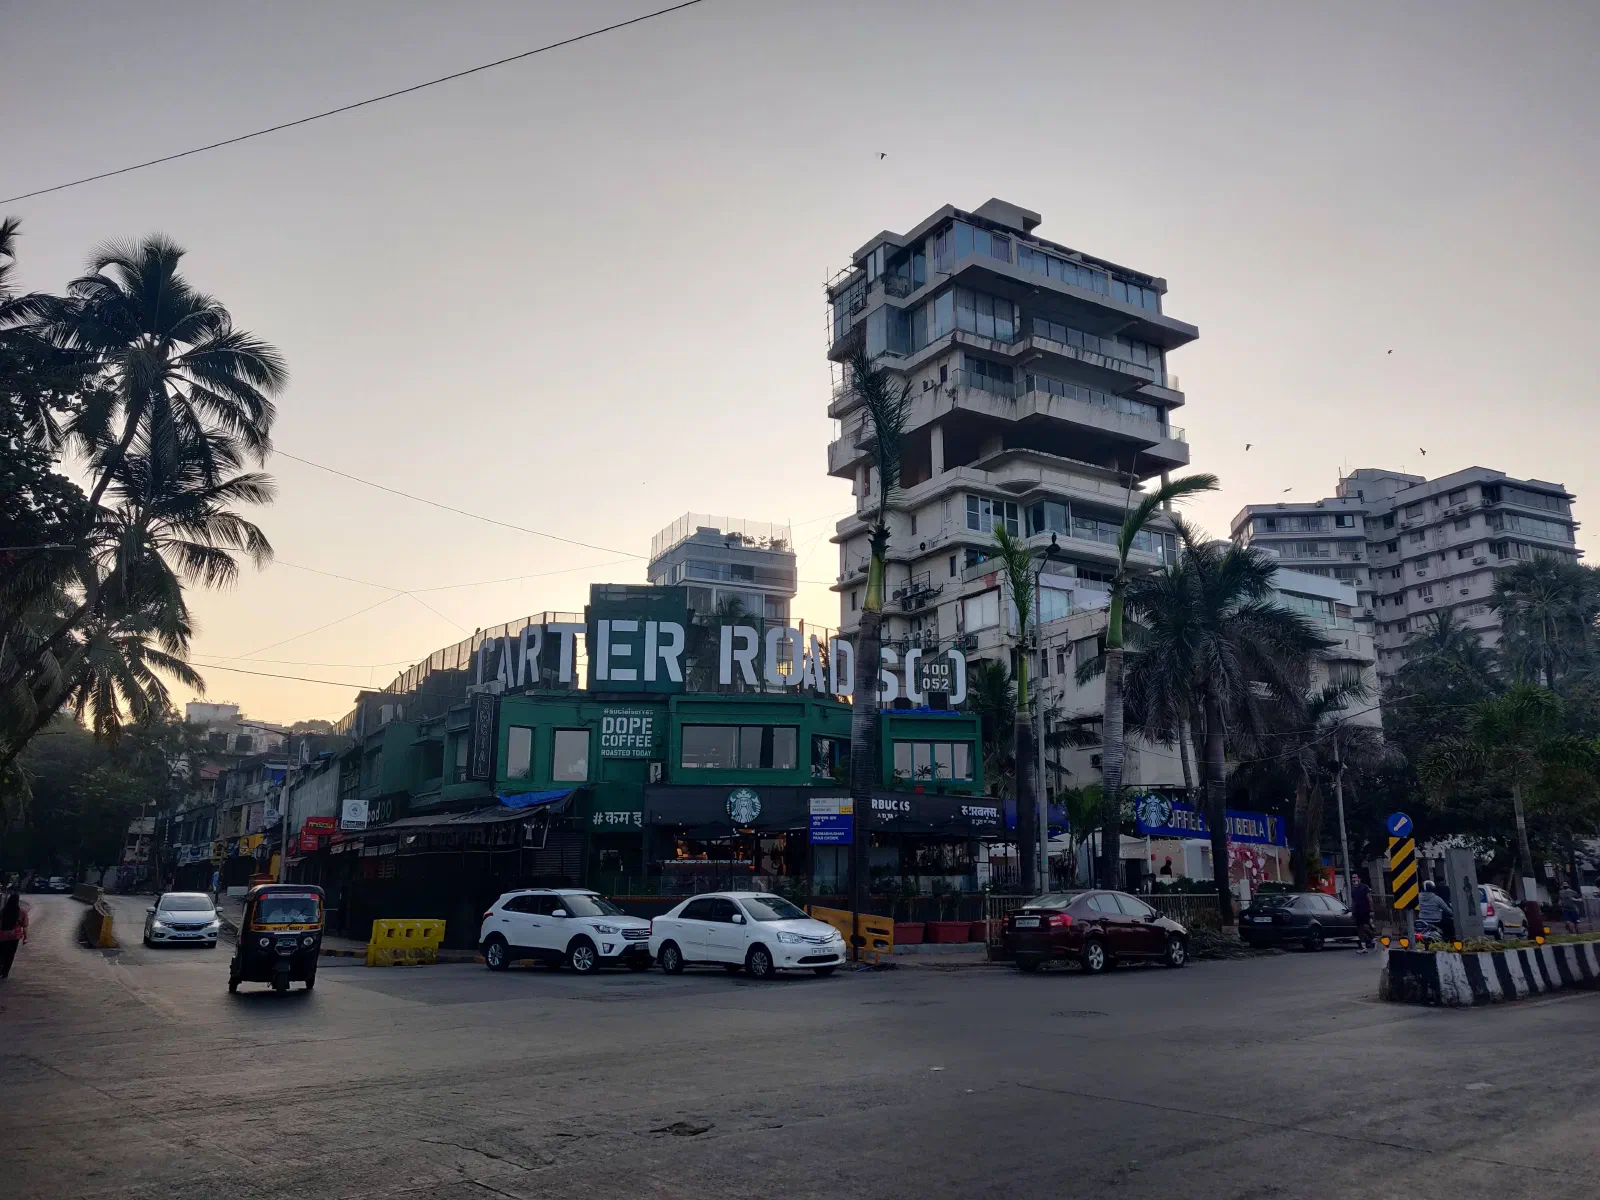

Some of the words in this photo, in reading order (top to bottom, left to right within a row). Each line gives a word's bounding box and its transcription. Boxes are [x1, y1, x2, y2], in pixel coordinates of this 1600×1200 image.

[476, 619, 686, 691] CARTER
[718, 625, 855, 696] ROAD
[922, 664, 950, 675] 400
[922, 678, 951, 690] 052
[602, 716, 653, 735] DOPE
[601, 734, 652, 747] COFFEE
[1236, 818, 1266, 838] BELLA
